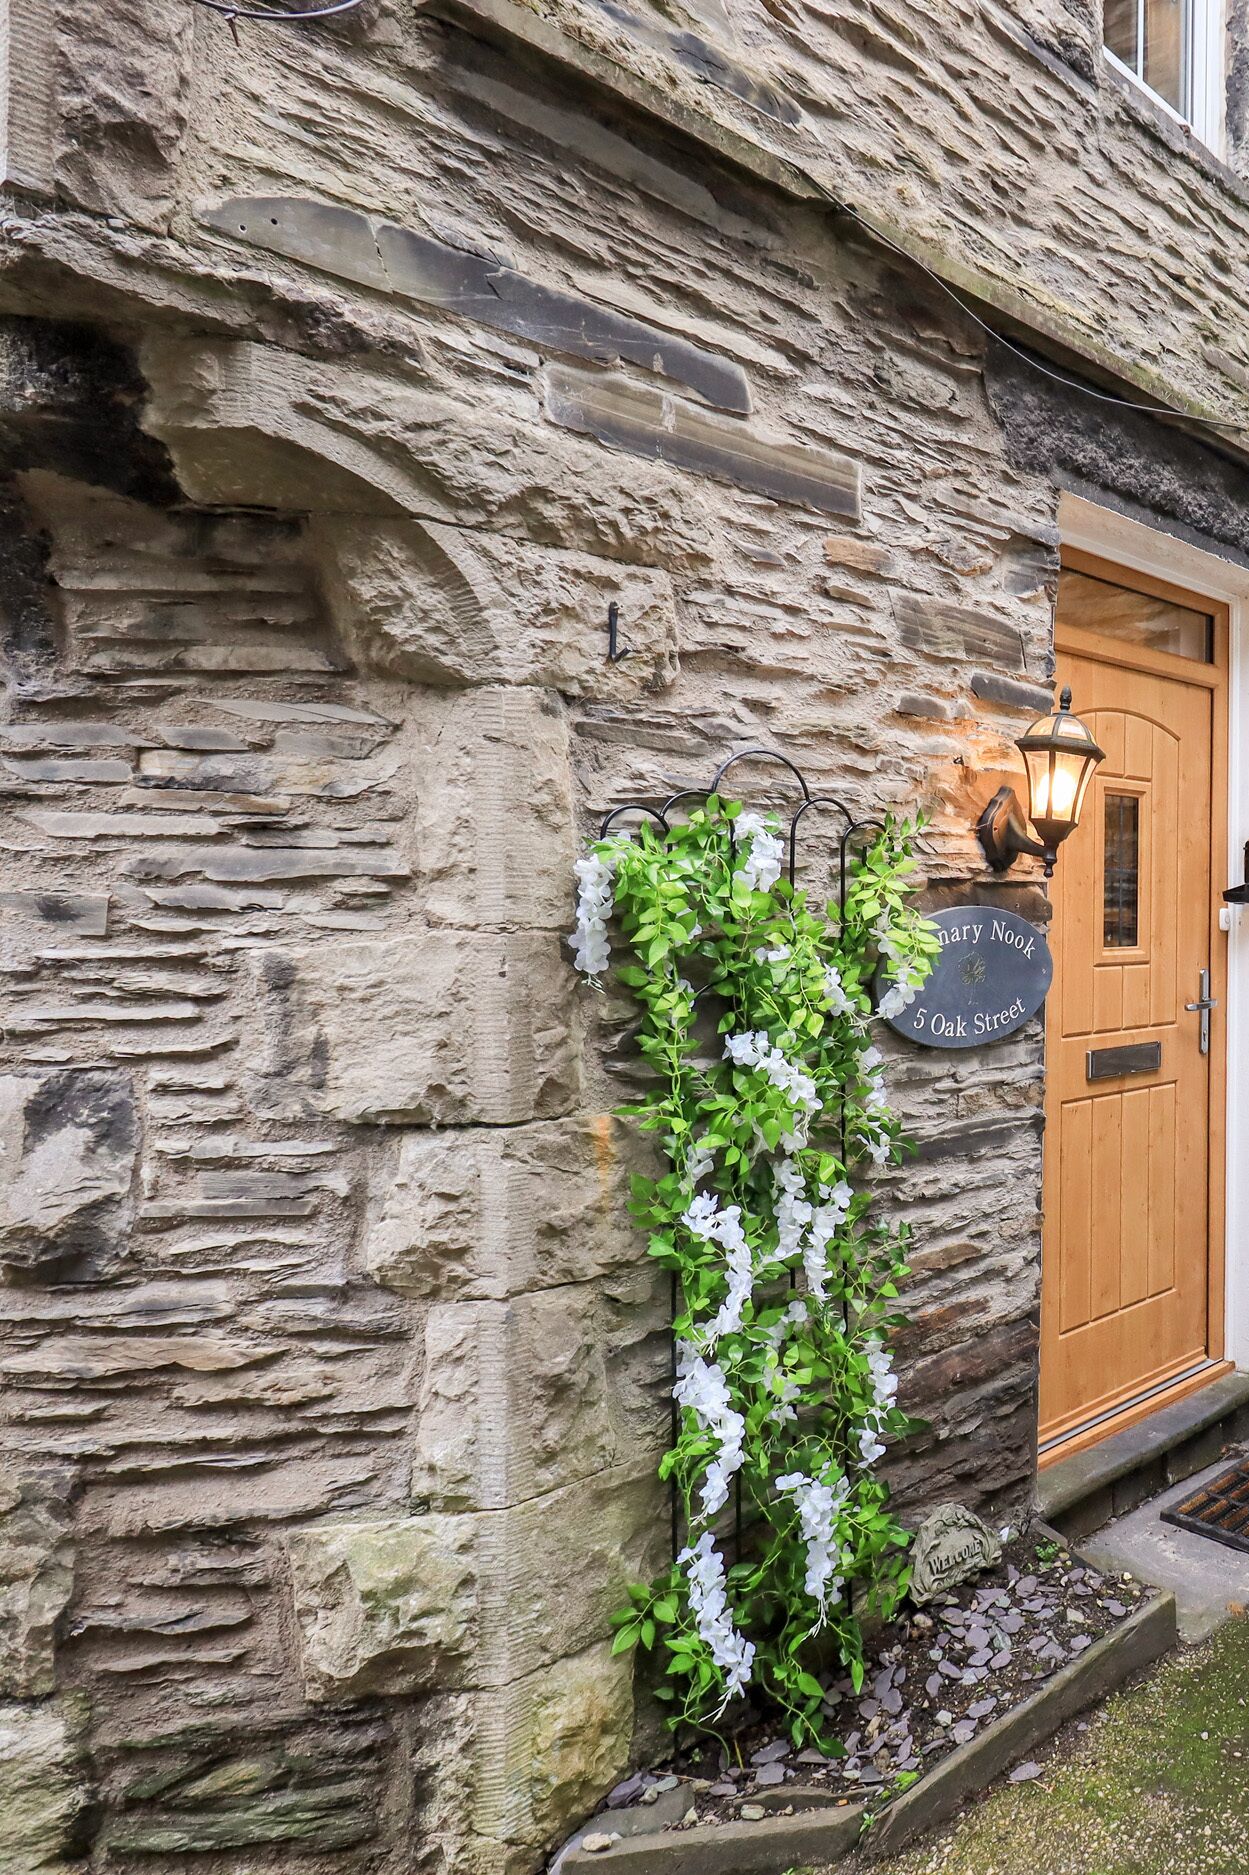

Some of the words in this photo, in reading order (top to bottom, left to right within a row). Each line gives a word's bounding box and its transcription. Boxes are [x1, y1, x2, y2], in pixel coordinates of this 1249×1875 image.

[937, 923, 984, 947] nary
[990, 919, 1036, 960] Nook
[913, 1008, 928, 1029] 5
[931, 1012, 967, 1037] Oak
[974, 996, 1026, 1035] Street
[928, 1539, 981, 1575] WELCOME
